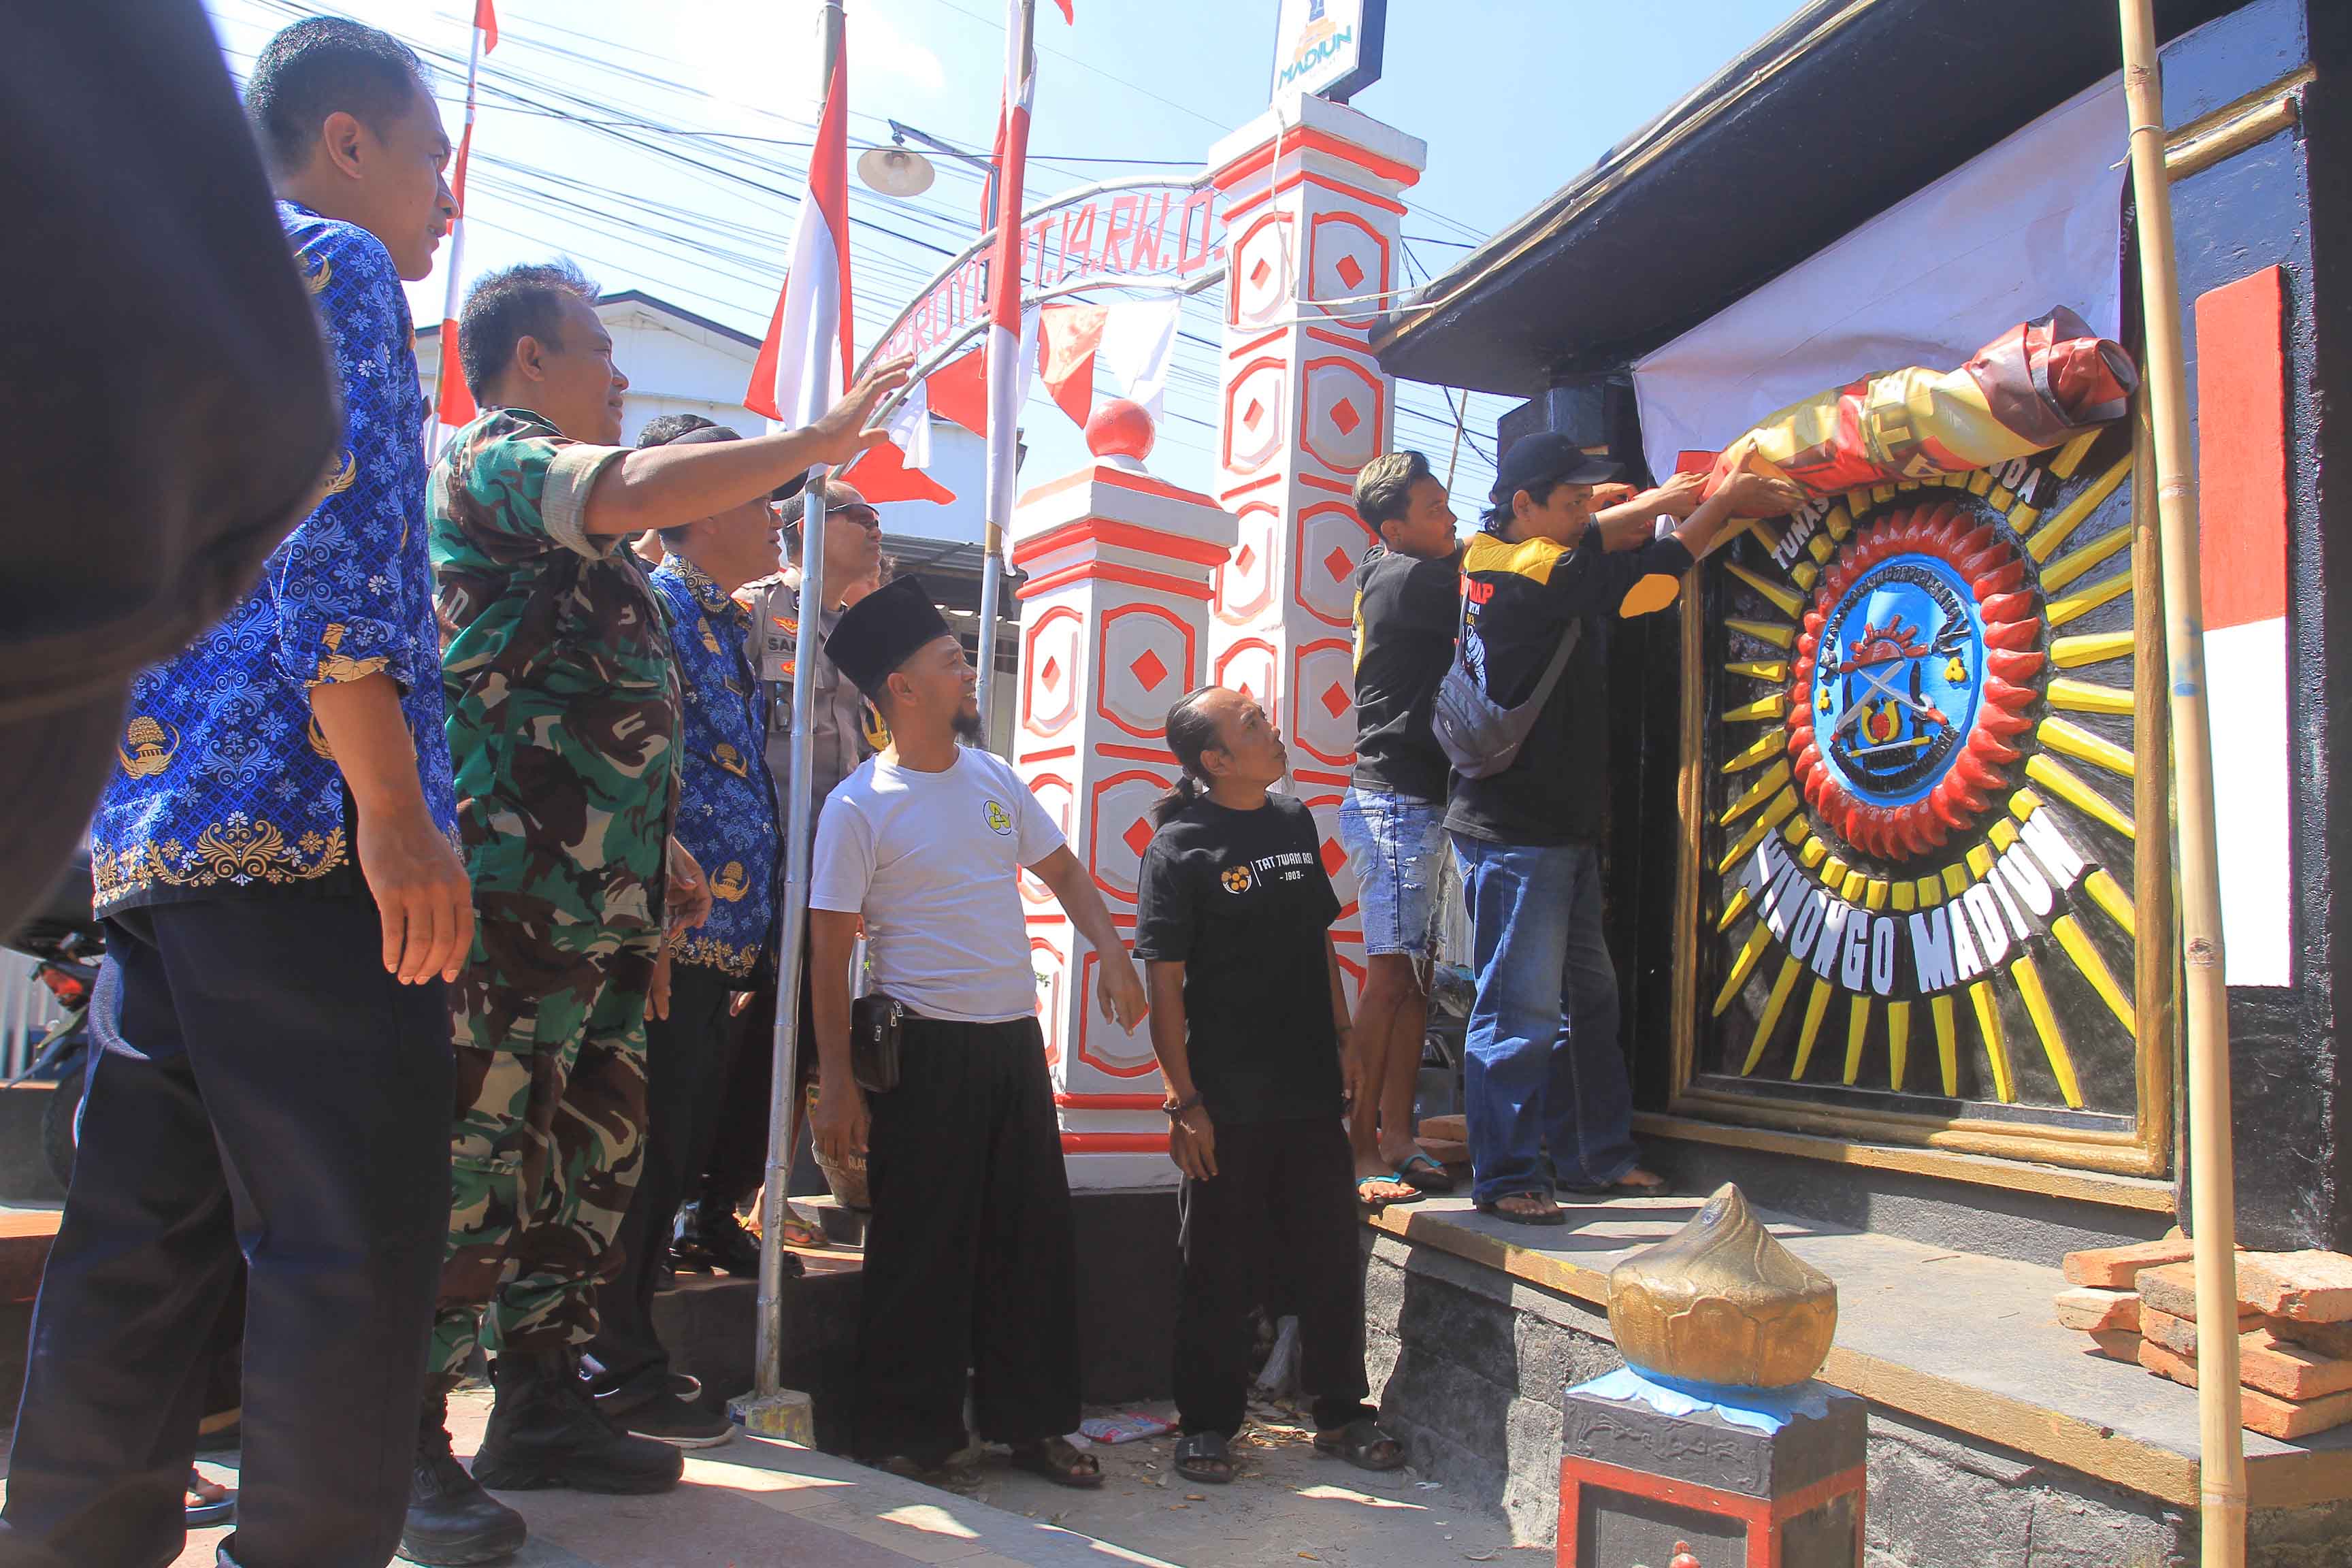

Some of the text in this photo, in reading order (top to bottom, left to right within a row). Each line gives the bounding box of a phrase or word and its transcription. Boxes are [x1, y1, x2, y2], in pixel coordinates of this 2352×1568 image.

[1278, 24, 1352, 91] MADIUN
[1771, 497, 1829, 570] TUNAS
[1256, 852, 1313, 872] TAT TWAM ASI
[1739, 806, 2087, 996] WINONGO MADIUN
